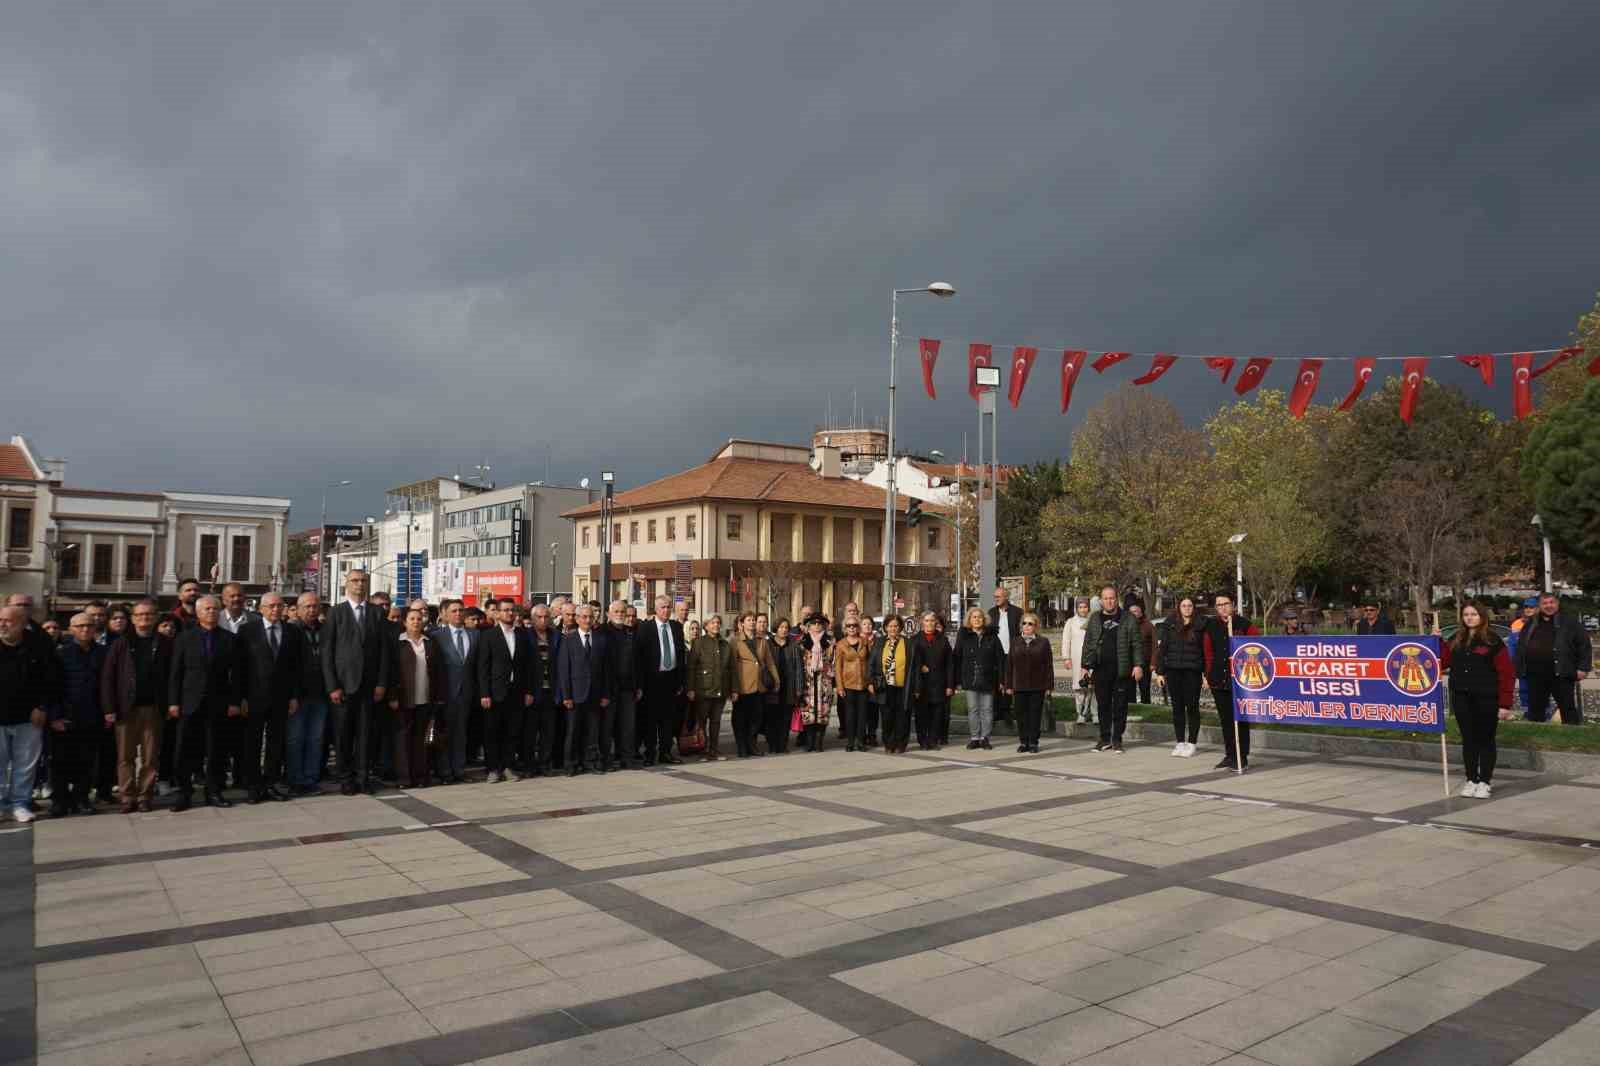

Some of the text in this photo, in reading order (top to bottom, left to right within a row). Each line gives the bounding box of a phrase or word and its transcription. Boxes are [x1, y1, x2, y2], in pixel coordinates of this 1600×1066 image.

[1297, 642, 1357, 657] EDİRNE
[1287, 659, 1369, 676] TİCARET
[1299, 678, 1360, 696] LİSESİ
[1237, 696, 1438, 725] YETİŞENLER DERNEĞİ
